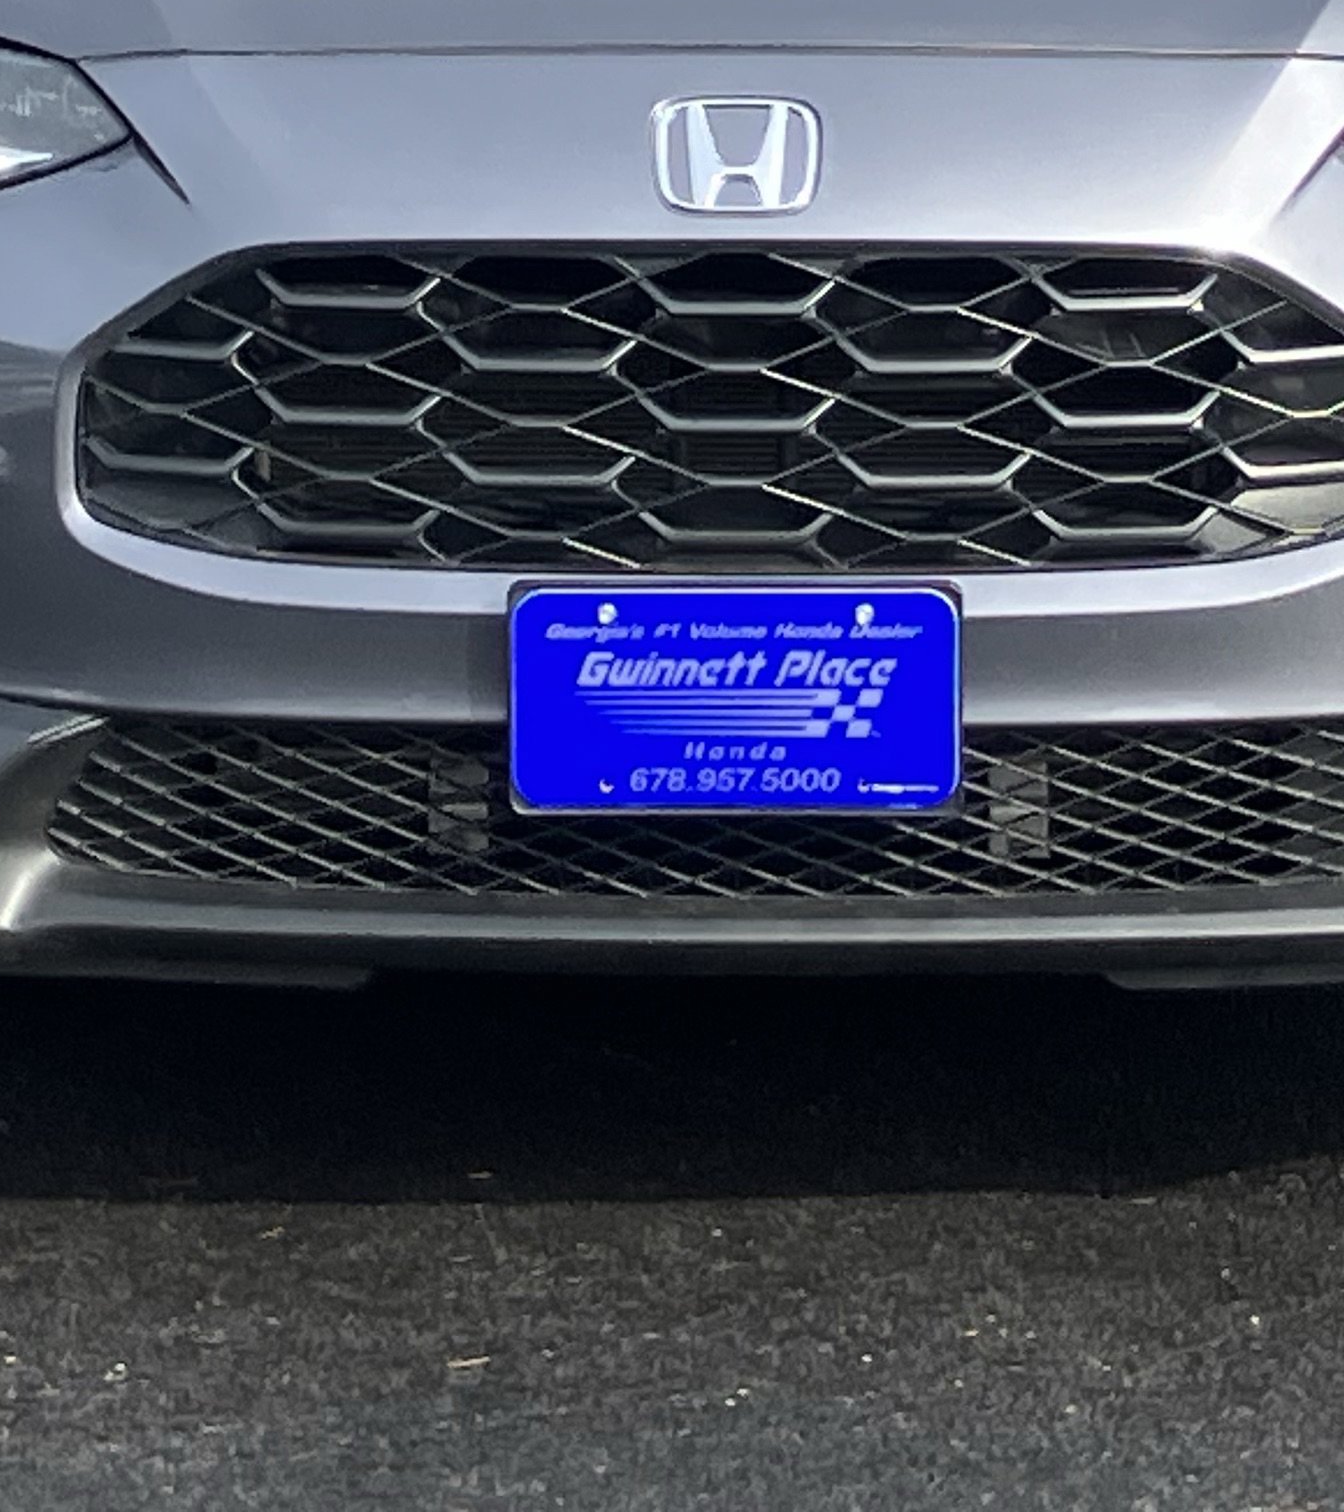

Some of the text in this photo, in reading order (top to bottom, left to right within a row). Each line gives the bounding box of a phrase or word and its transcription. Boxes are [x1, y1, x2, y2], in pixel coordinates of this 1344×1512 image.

[773, 621, 844, 639] Honda
[576, 649, 898, 687] Gwinnett Place
[683, 741, 786, 761] Honda
